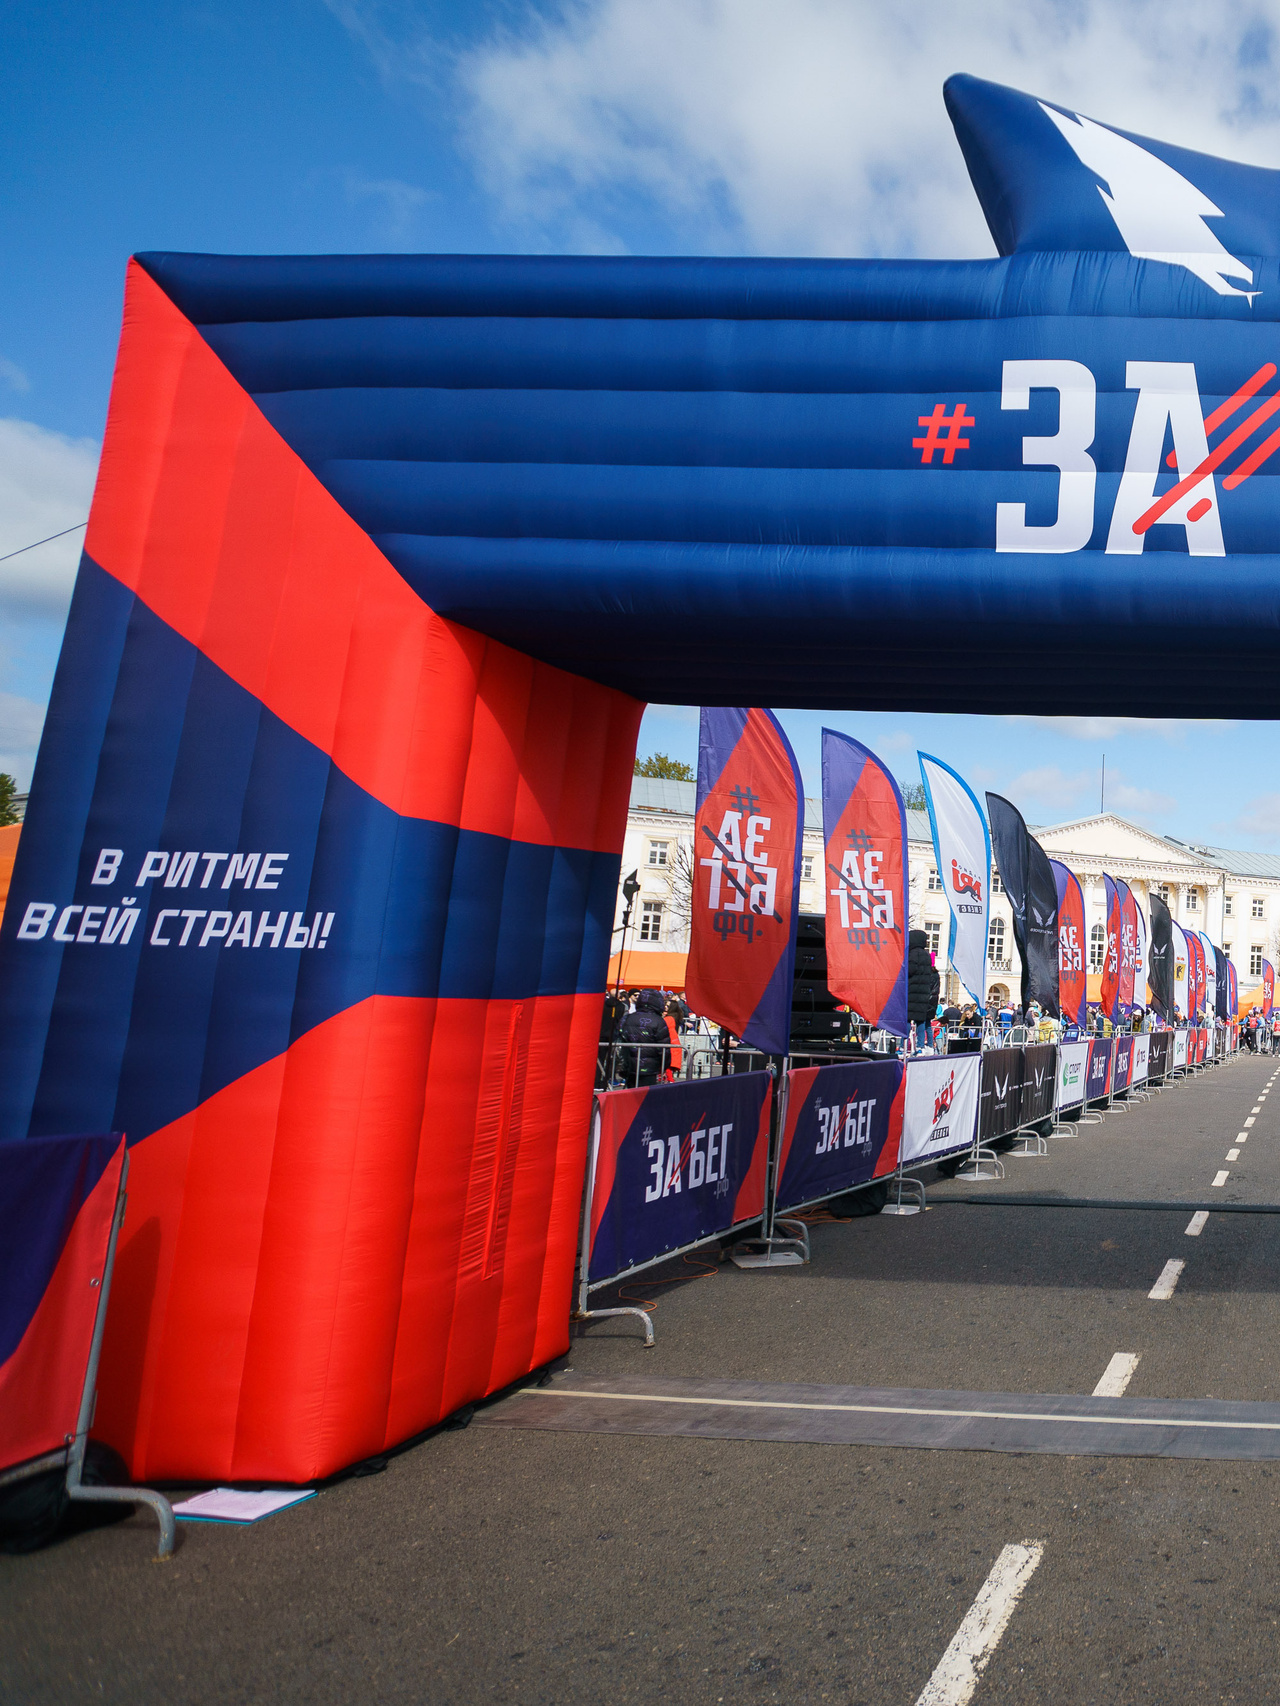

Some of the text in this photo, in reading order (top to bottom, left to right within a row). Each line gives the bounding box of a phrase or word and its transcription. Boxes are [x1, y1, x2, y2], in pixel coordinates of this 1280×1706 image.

[91, 848, 289, 889] В РИТМЕ
[17, 897, 335, 949] ВСЕЙ СТРАНЫ!
